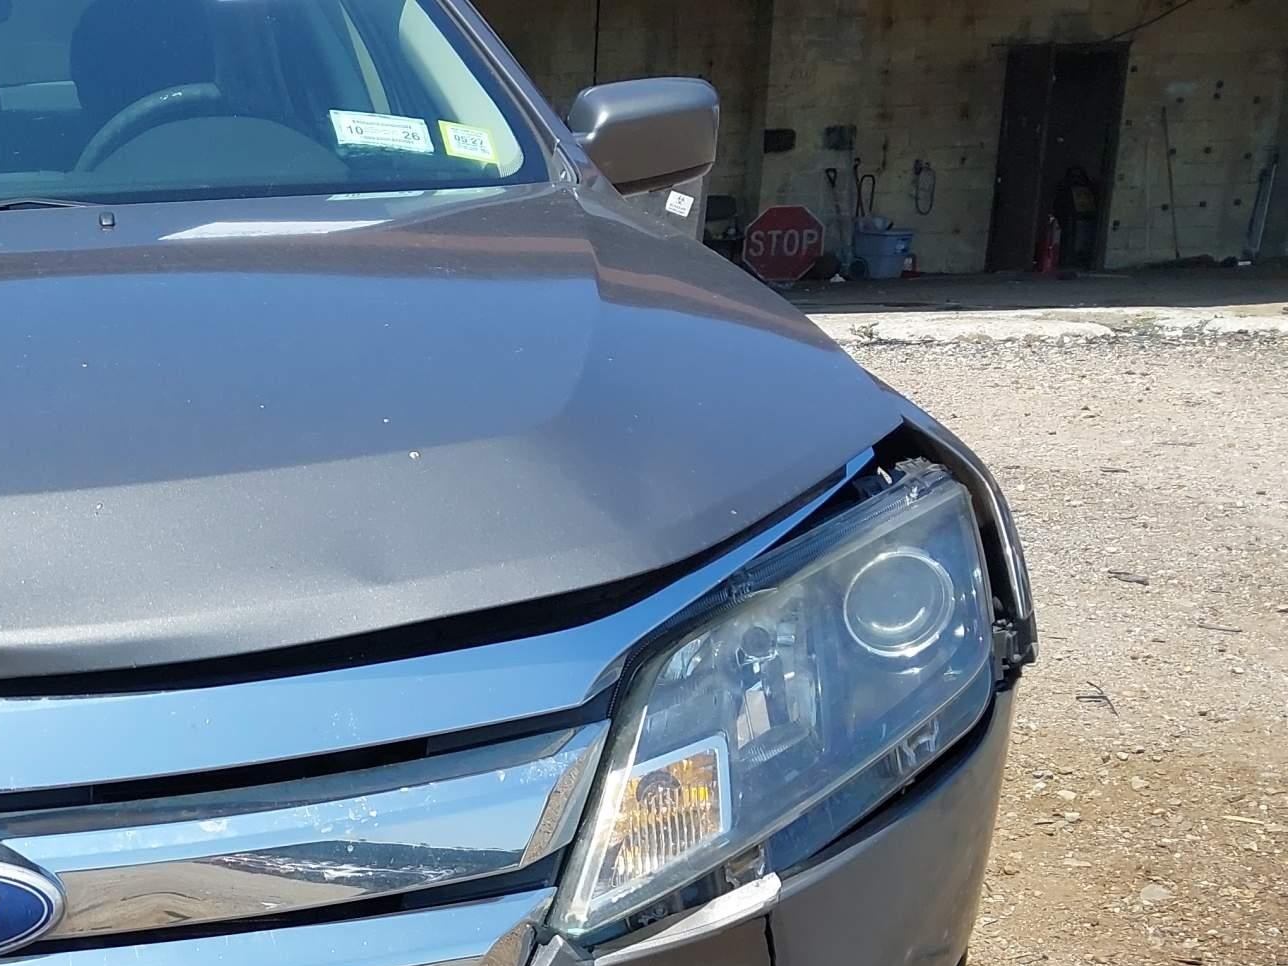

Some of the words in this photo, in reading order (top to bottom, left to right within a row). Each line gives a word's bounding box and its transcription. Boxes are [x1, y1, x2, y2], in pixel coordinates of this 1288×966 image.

[346, 125, 364, 135] 10
[402, 130, 421, 141] 26
[748, 228, 819, 257] STOP
